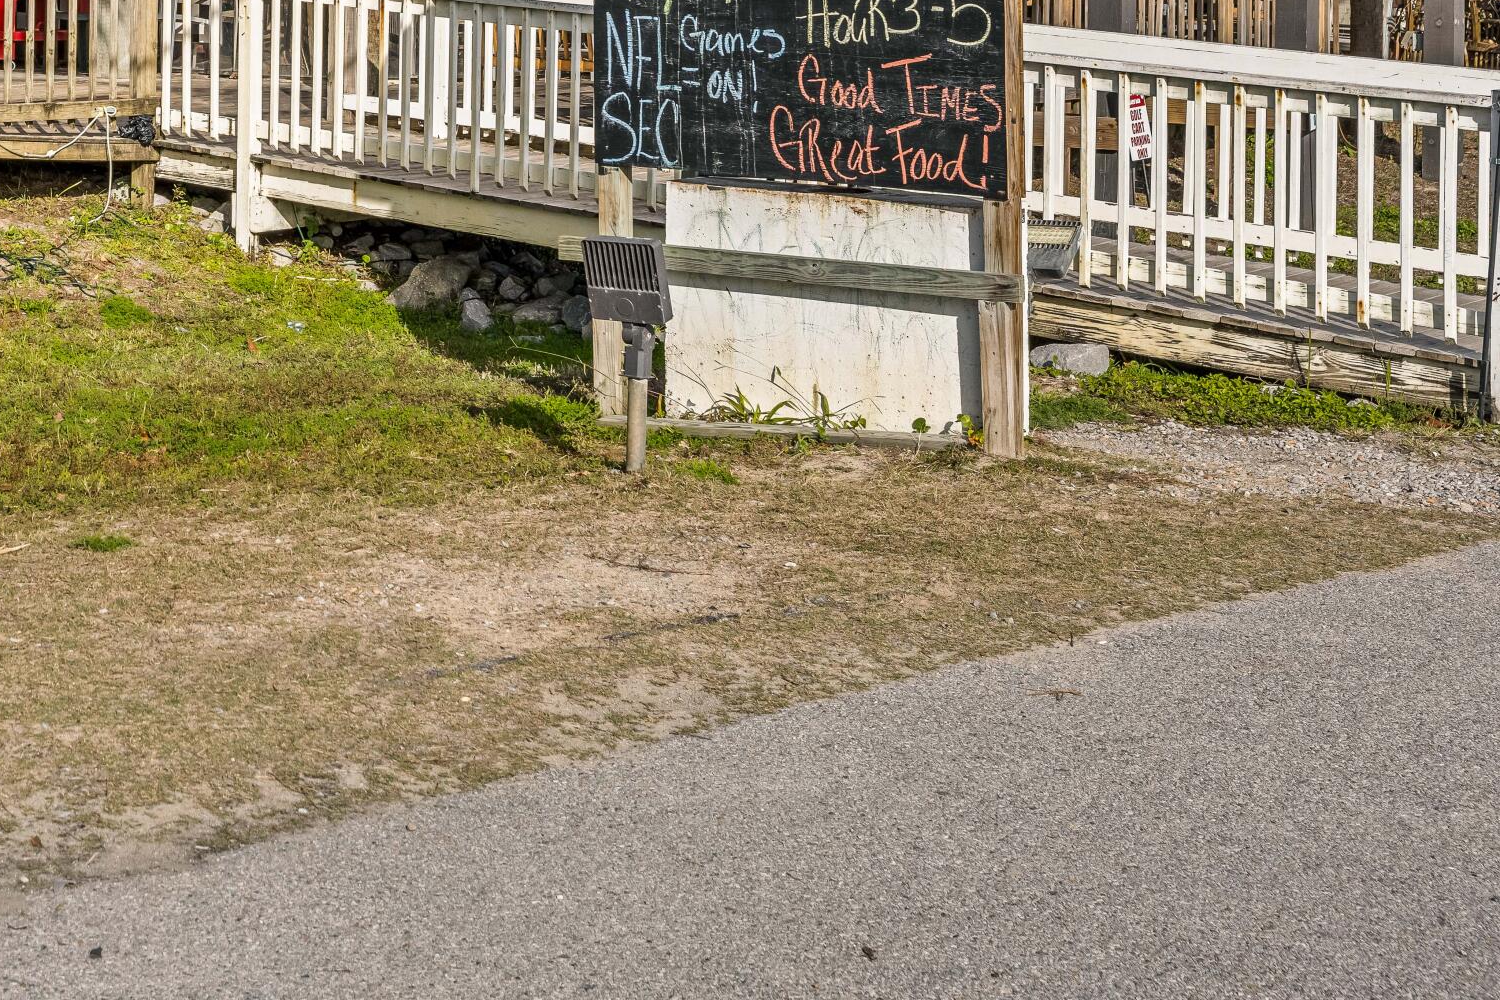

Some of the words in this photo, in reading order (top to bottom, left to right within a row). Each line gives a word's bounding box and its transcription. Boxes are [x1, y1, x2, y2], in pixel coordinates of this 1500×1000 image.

[606, 8, 683, 91] NFL
[680, 13, 786, 60] Games
[797, 53, 885, 114] Good
[602, 91, 680, 167] SEC
[1130, 108, 1142, 121] GOLF
[1131, 121, 1145, 134] CART
[1130, 133, 1151, 148] PARKING
